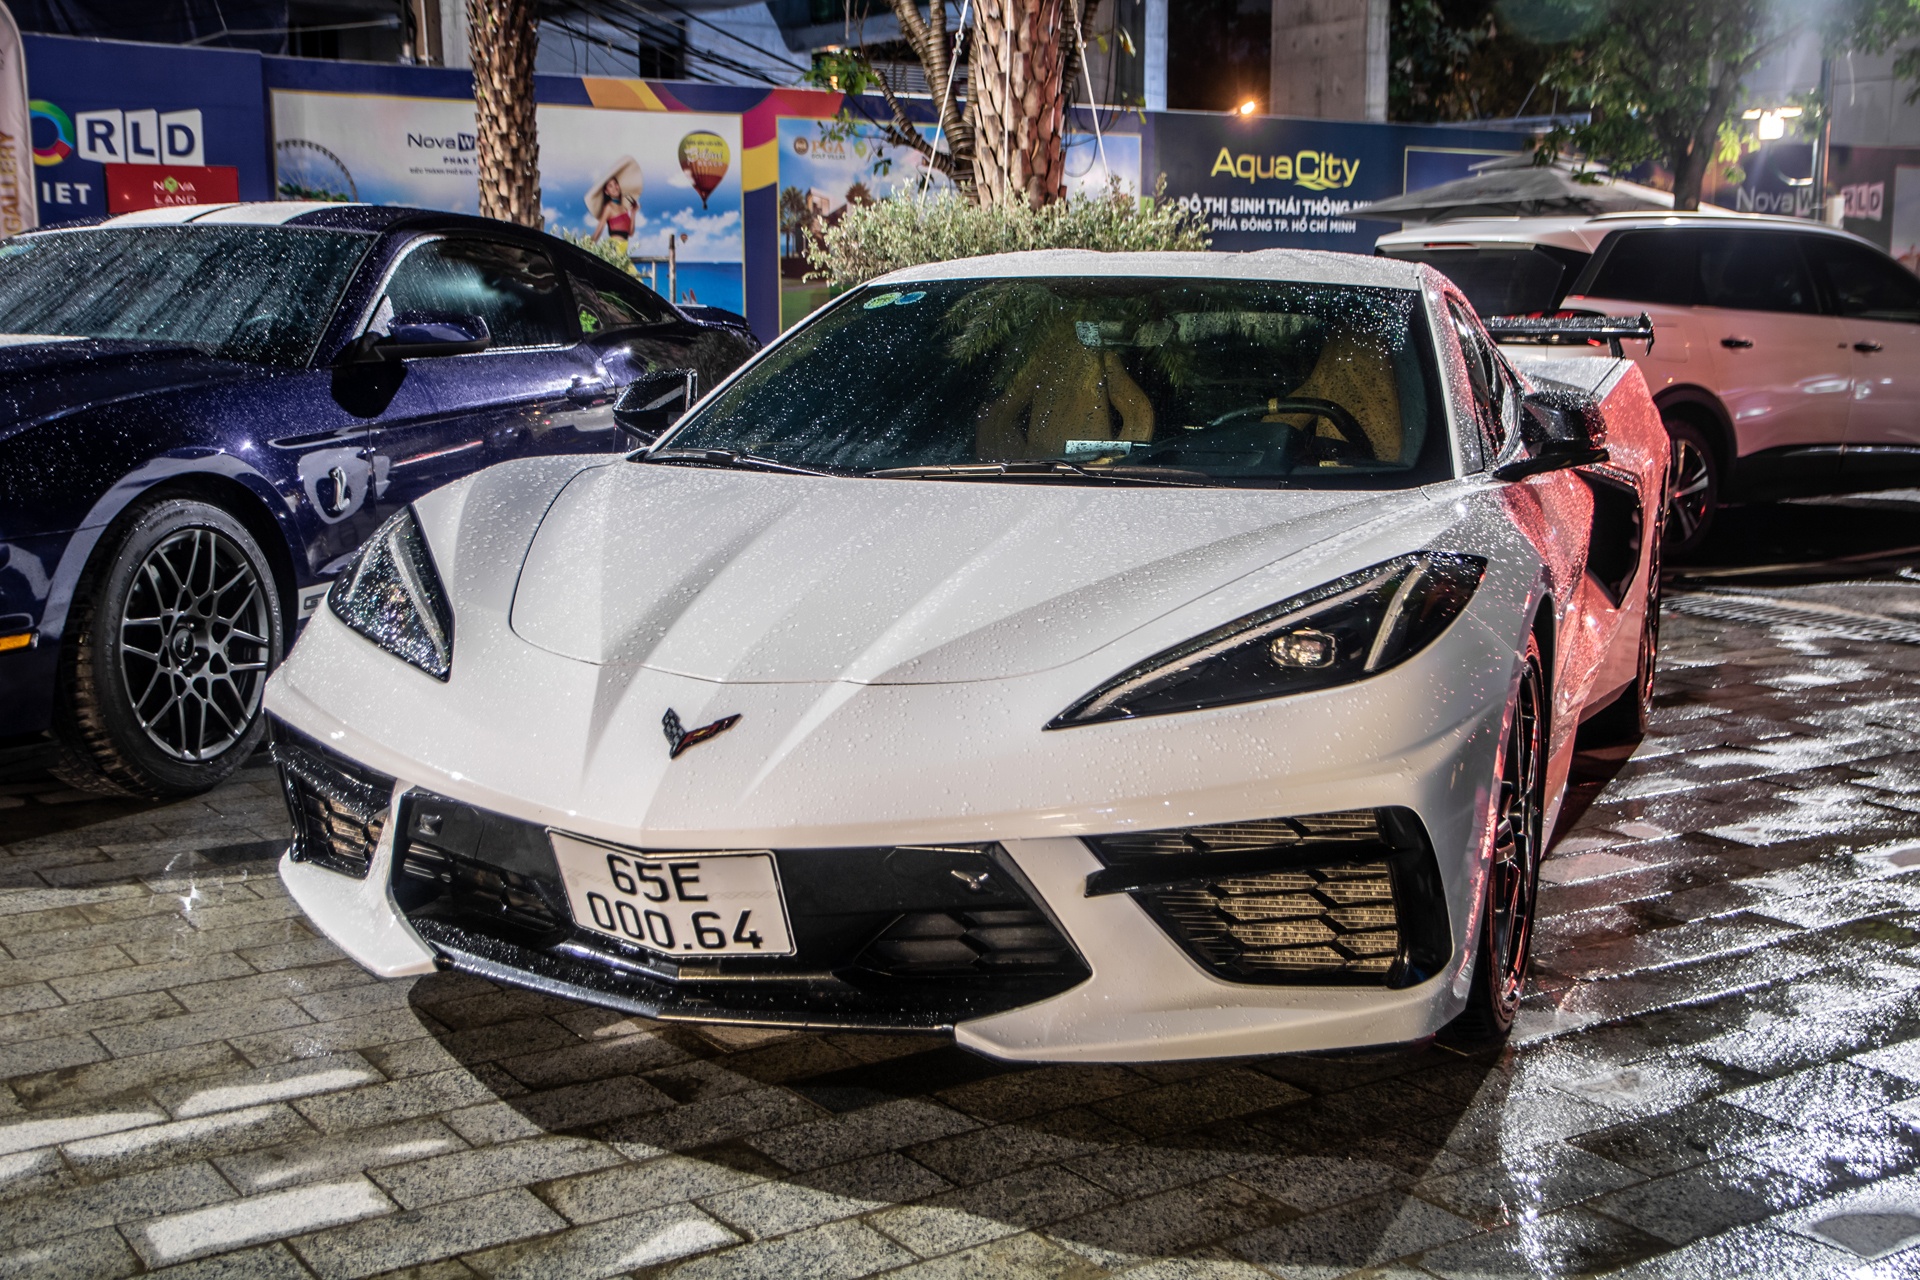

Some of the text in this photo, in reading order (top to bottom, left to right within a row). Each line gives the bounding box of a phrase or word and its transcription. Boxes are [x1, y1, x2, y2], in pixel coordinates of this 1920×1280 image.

[154, 193, 198, 205] LAND
[1231, 197, 1265, 214] SINH
[1267, 195, 1300, 216] THÁI
[1212, 215, 1238, 231] PHÍA
[1240, 215, 1273, 232] ĐÔNG
[1274, 219, 1289, 232] TP.
[1309, 217, 1328, 233] CHÍ
[1329, 220, 1357, 234] MINH
[606, 853, 709, 902] 65E
[586, 890, 764, 950] 000.64
